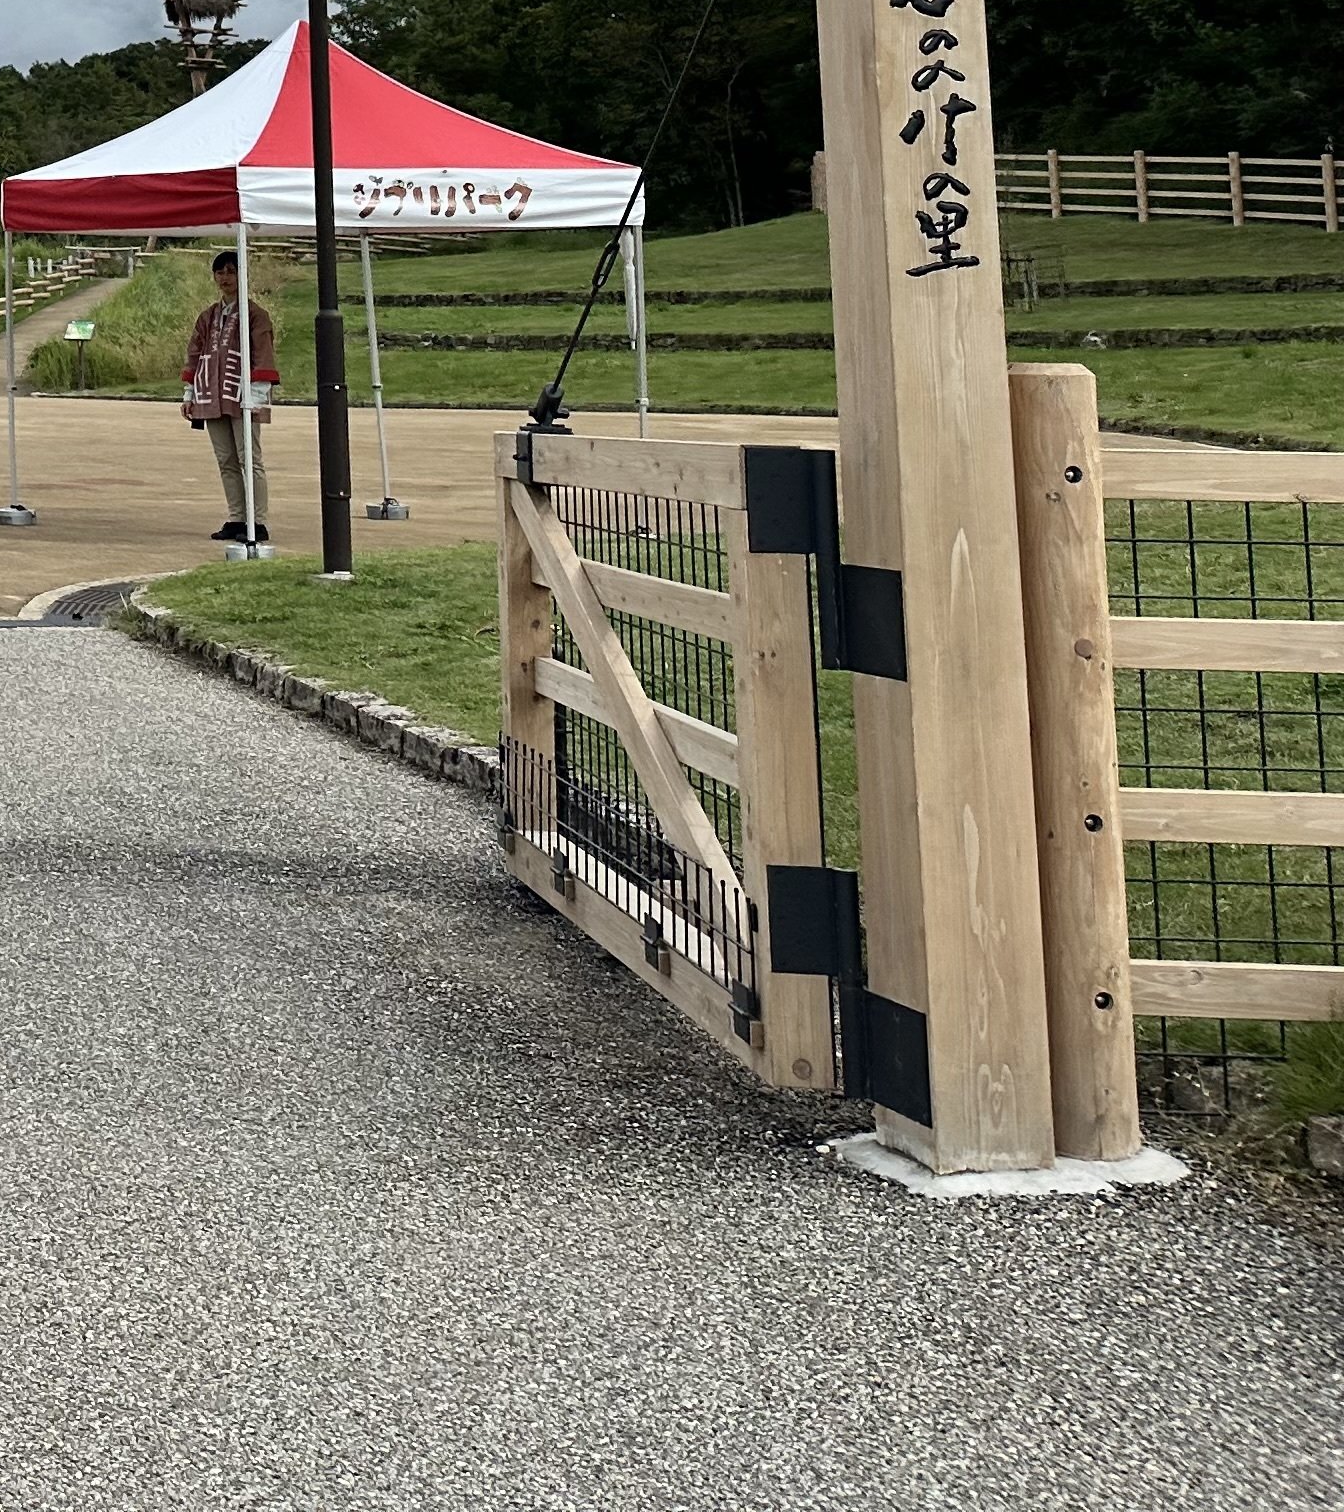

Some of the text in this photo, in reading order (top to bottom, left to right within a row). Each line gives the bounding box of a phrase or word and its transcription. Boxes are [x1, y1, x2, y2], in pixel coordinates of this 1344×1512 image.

[353, 175, 533, 221] ジブリパーク
